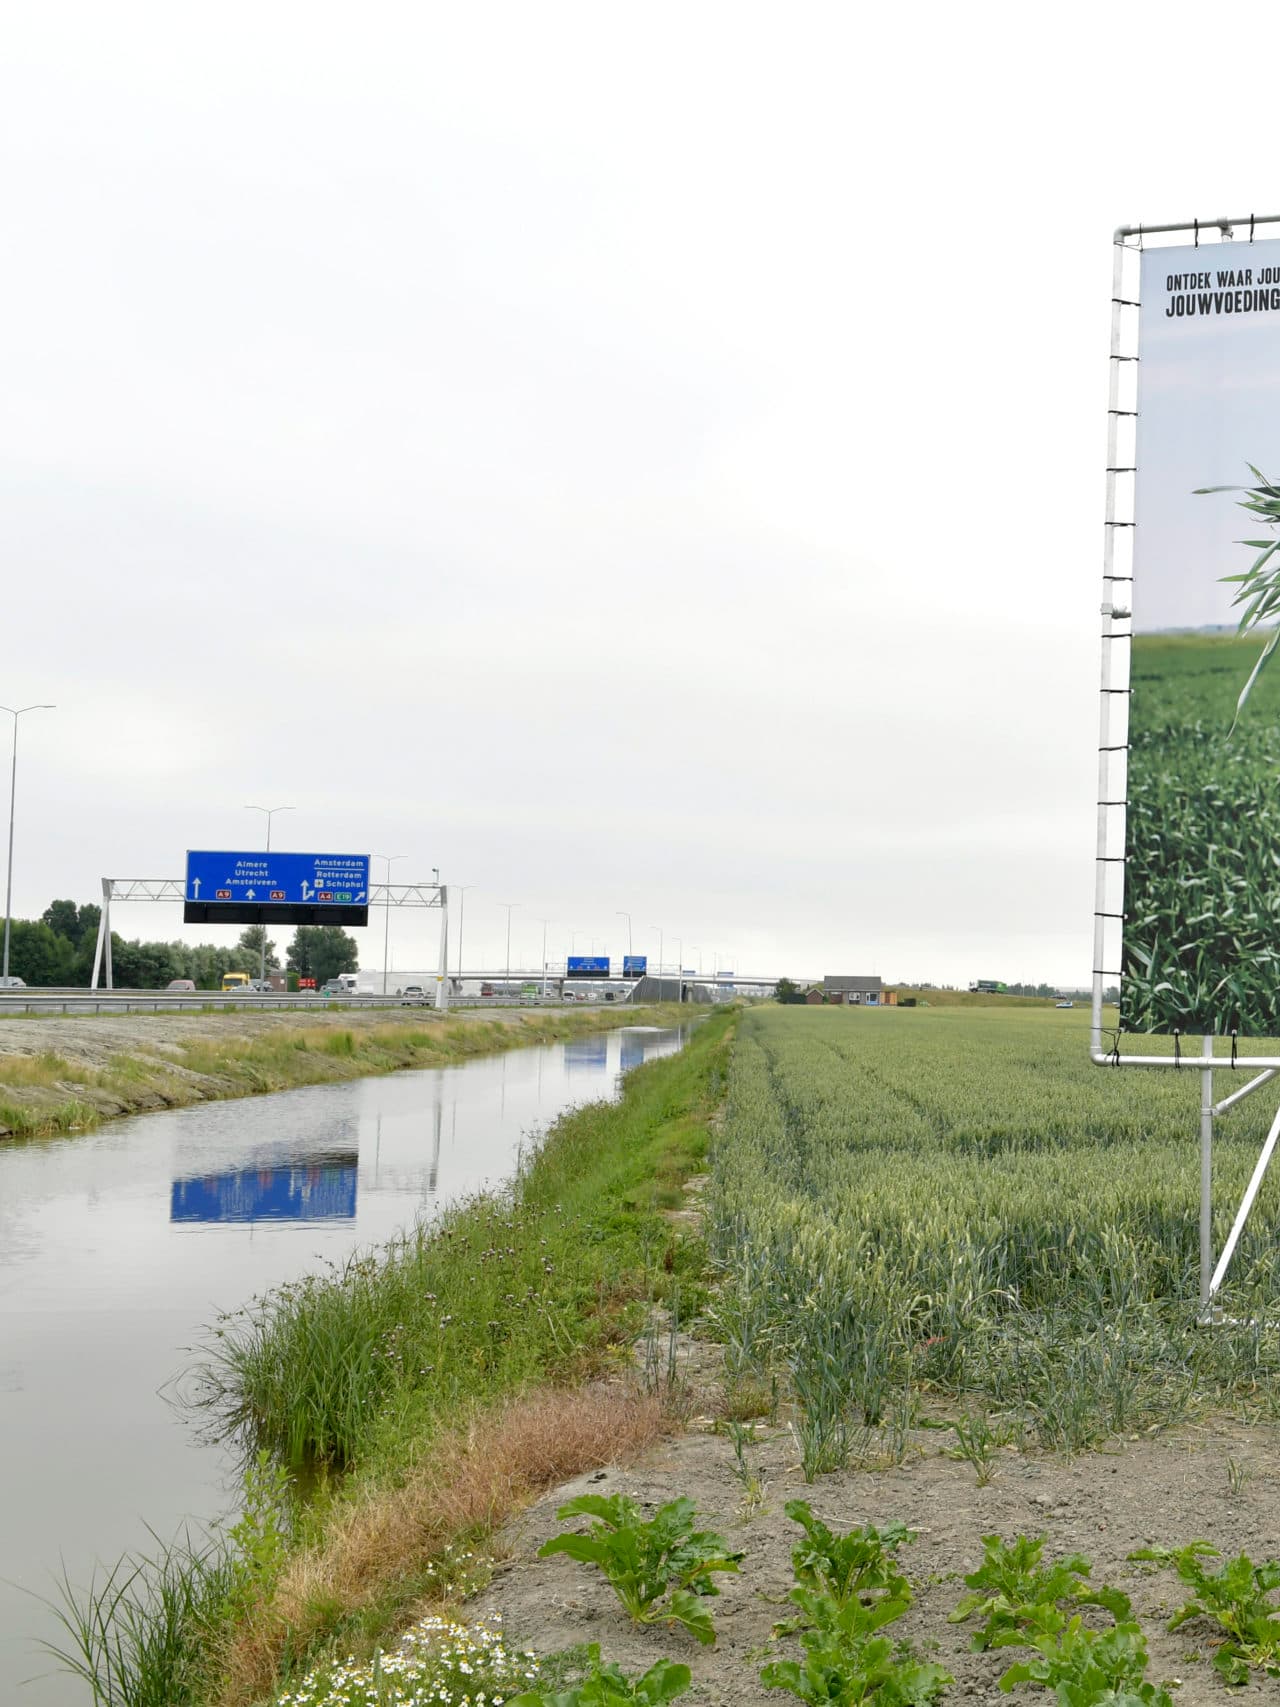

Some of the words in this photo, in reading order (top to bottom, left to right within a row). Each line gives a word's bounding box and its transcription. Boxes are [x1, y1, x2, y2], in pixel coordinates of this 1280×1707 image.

[1167, 272, 1211, 292] ONTDEK
[1217, 269, 1252, 289] WAAR
[236, 860, 268, 868] Almere
[314, 859, 364, 867] Amsterdam
[235, 869, 269, 877] Utrecht
[316, 871, 362, 879] Rotterdam
[225, 878, 278, 886] Amstelveen
[326, 880, 364, 888] Schiphol
